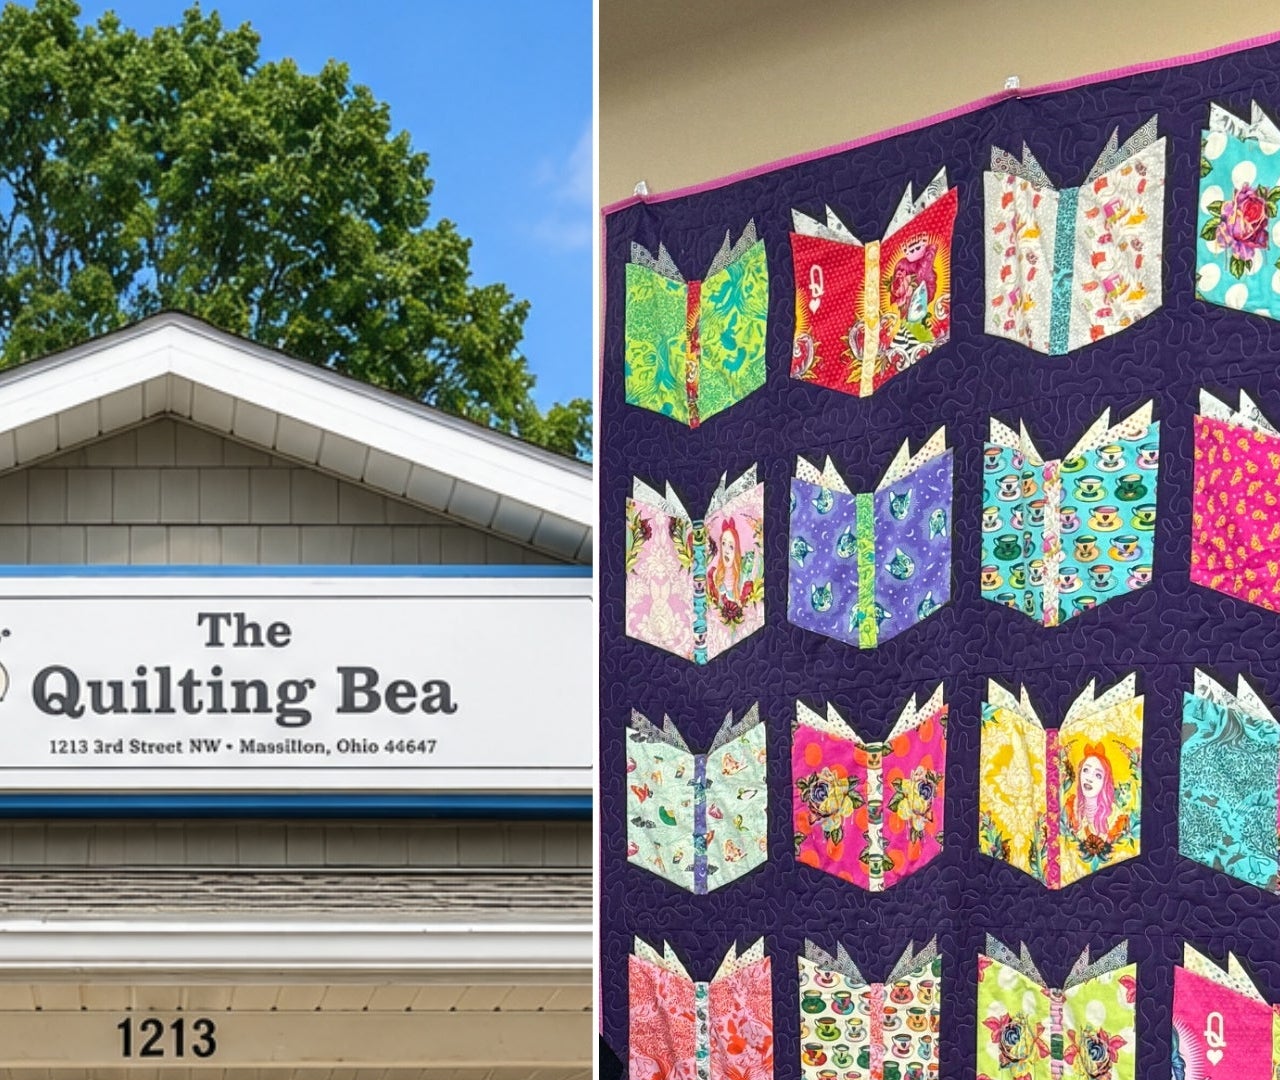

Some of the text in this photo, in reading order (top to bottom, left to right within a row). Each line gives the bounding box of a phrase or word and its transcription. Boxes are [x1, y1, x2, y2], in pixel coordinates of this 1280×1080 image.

[197, 612, 293, 649] The
[31, 665, 458, 729] Quilting Bea
[49, 738, 438, 757] 1213 3rd Street NW Massillon, Ohio 44647
[117, 1018, 217, 1059] 1213
